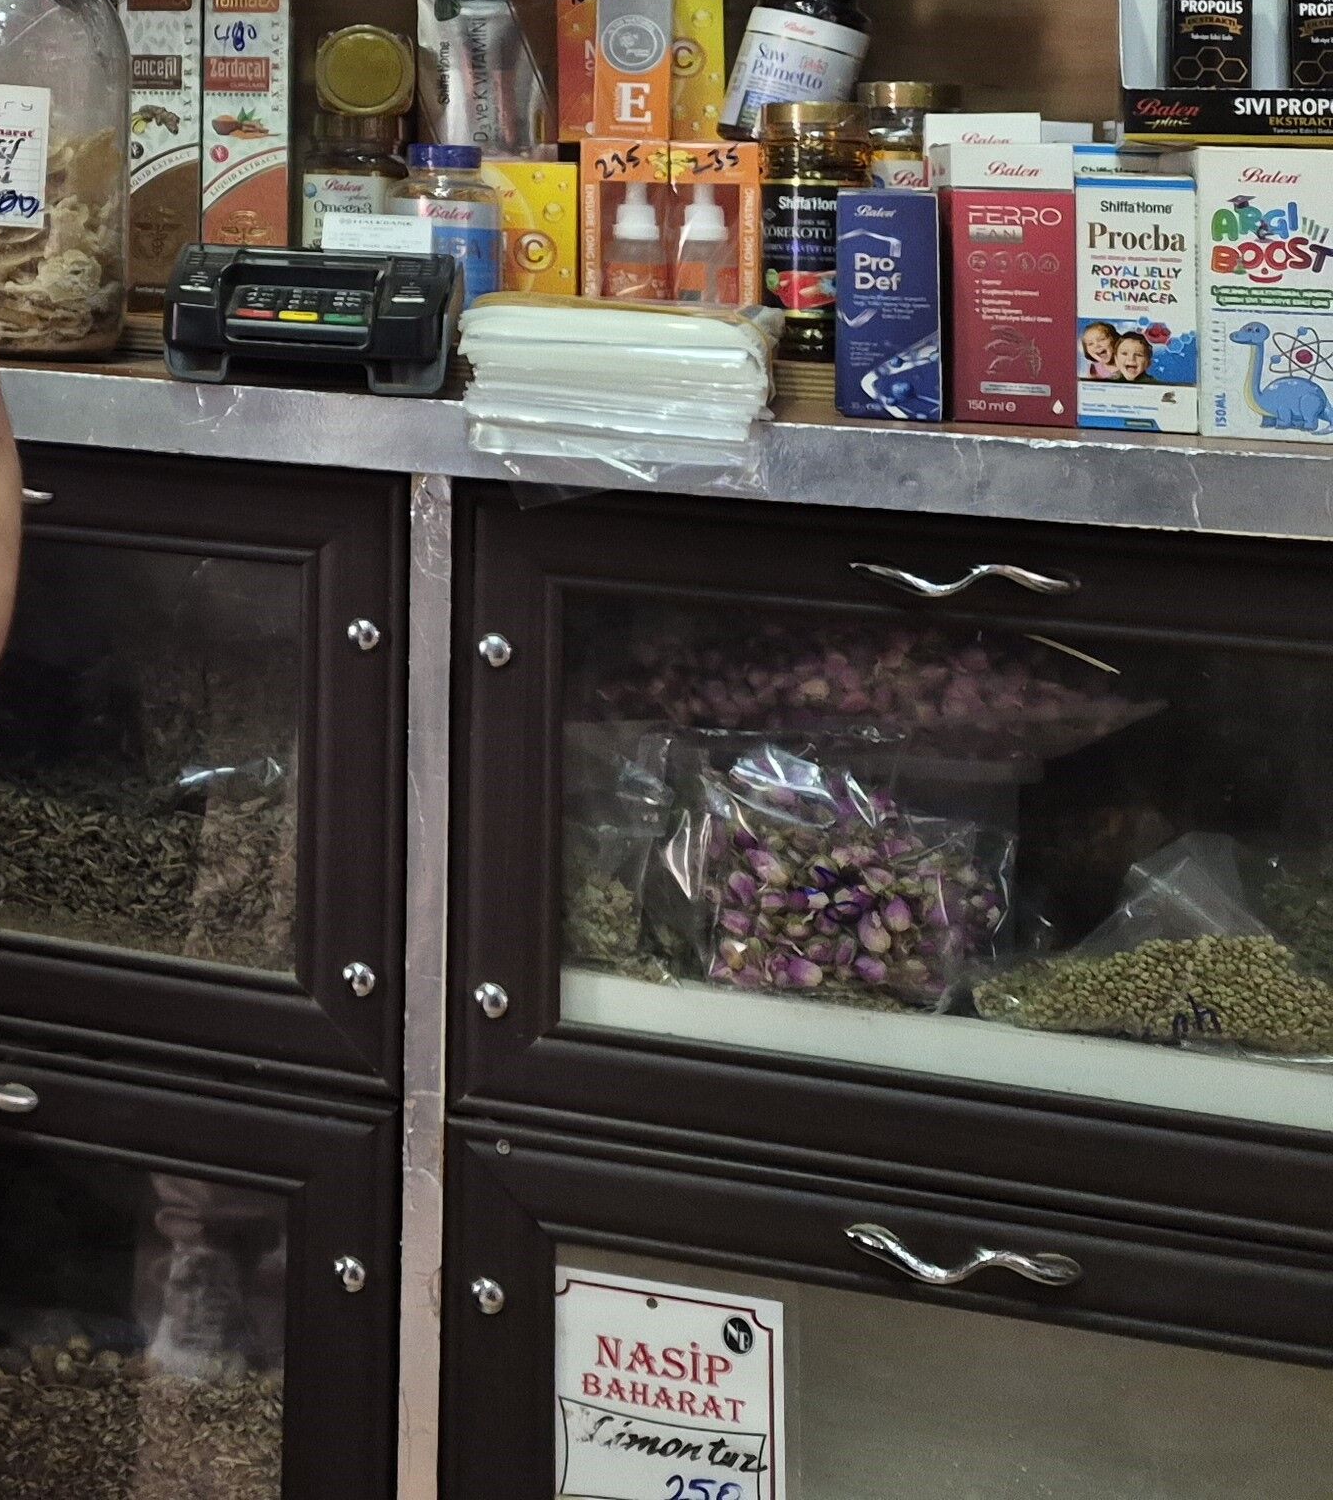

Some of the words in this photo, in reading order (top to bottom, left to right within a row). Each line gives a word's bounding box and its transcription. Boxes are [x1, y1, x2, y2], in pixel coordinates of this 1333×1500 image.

[674, 44, 695, 69] C
[751, 60, 825, 91] Palmetto
[615, 81, 653, 124] E
[1133, 99, 1202, 121] Balen
[1233, 97, 1272, 116] SIVI
[987, 160, 1044, 178] Balen
[1237, 166, 1302, 186] Balen
[322, 178, 365, 194] Balen
[313, 201, 374, 216] Omega-3
[419, 202, 475, 221] Balen
[854, 204, 897, 219] Balen
[967, 205, 1063, 227] FERRO
[1100, 199, 1135, 215] Shiffa
[1135, 201, 1174, 215] Home
[1211, 201, 1301, 242] ARGI
[1086, 220, 1187, 252] Procba
[523, 238, 544, 263] C
[1210, 236, 1333, 276] BOOST
[853, 251, 895, 273] Pro
[1090, 264, 1141, 278] ROYAL
[1144, 266, 1183, 280] JELLY
[853, 271, 902, 293] Def
[1100, 277, 1172, 291] PROPOLIS
[1093, 290, 1179, 305] ECHINACEA
[966, 399, 987, 413] 150
[594, 1333, 734, 1388] NASİP
[581, 1371, 748, 1425] BAHARAT
